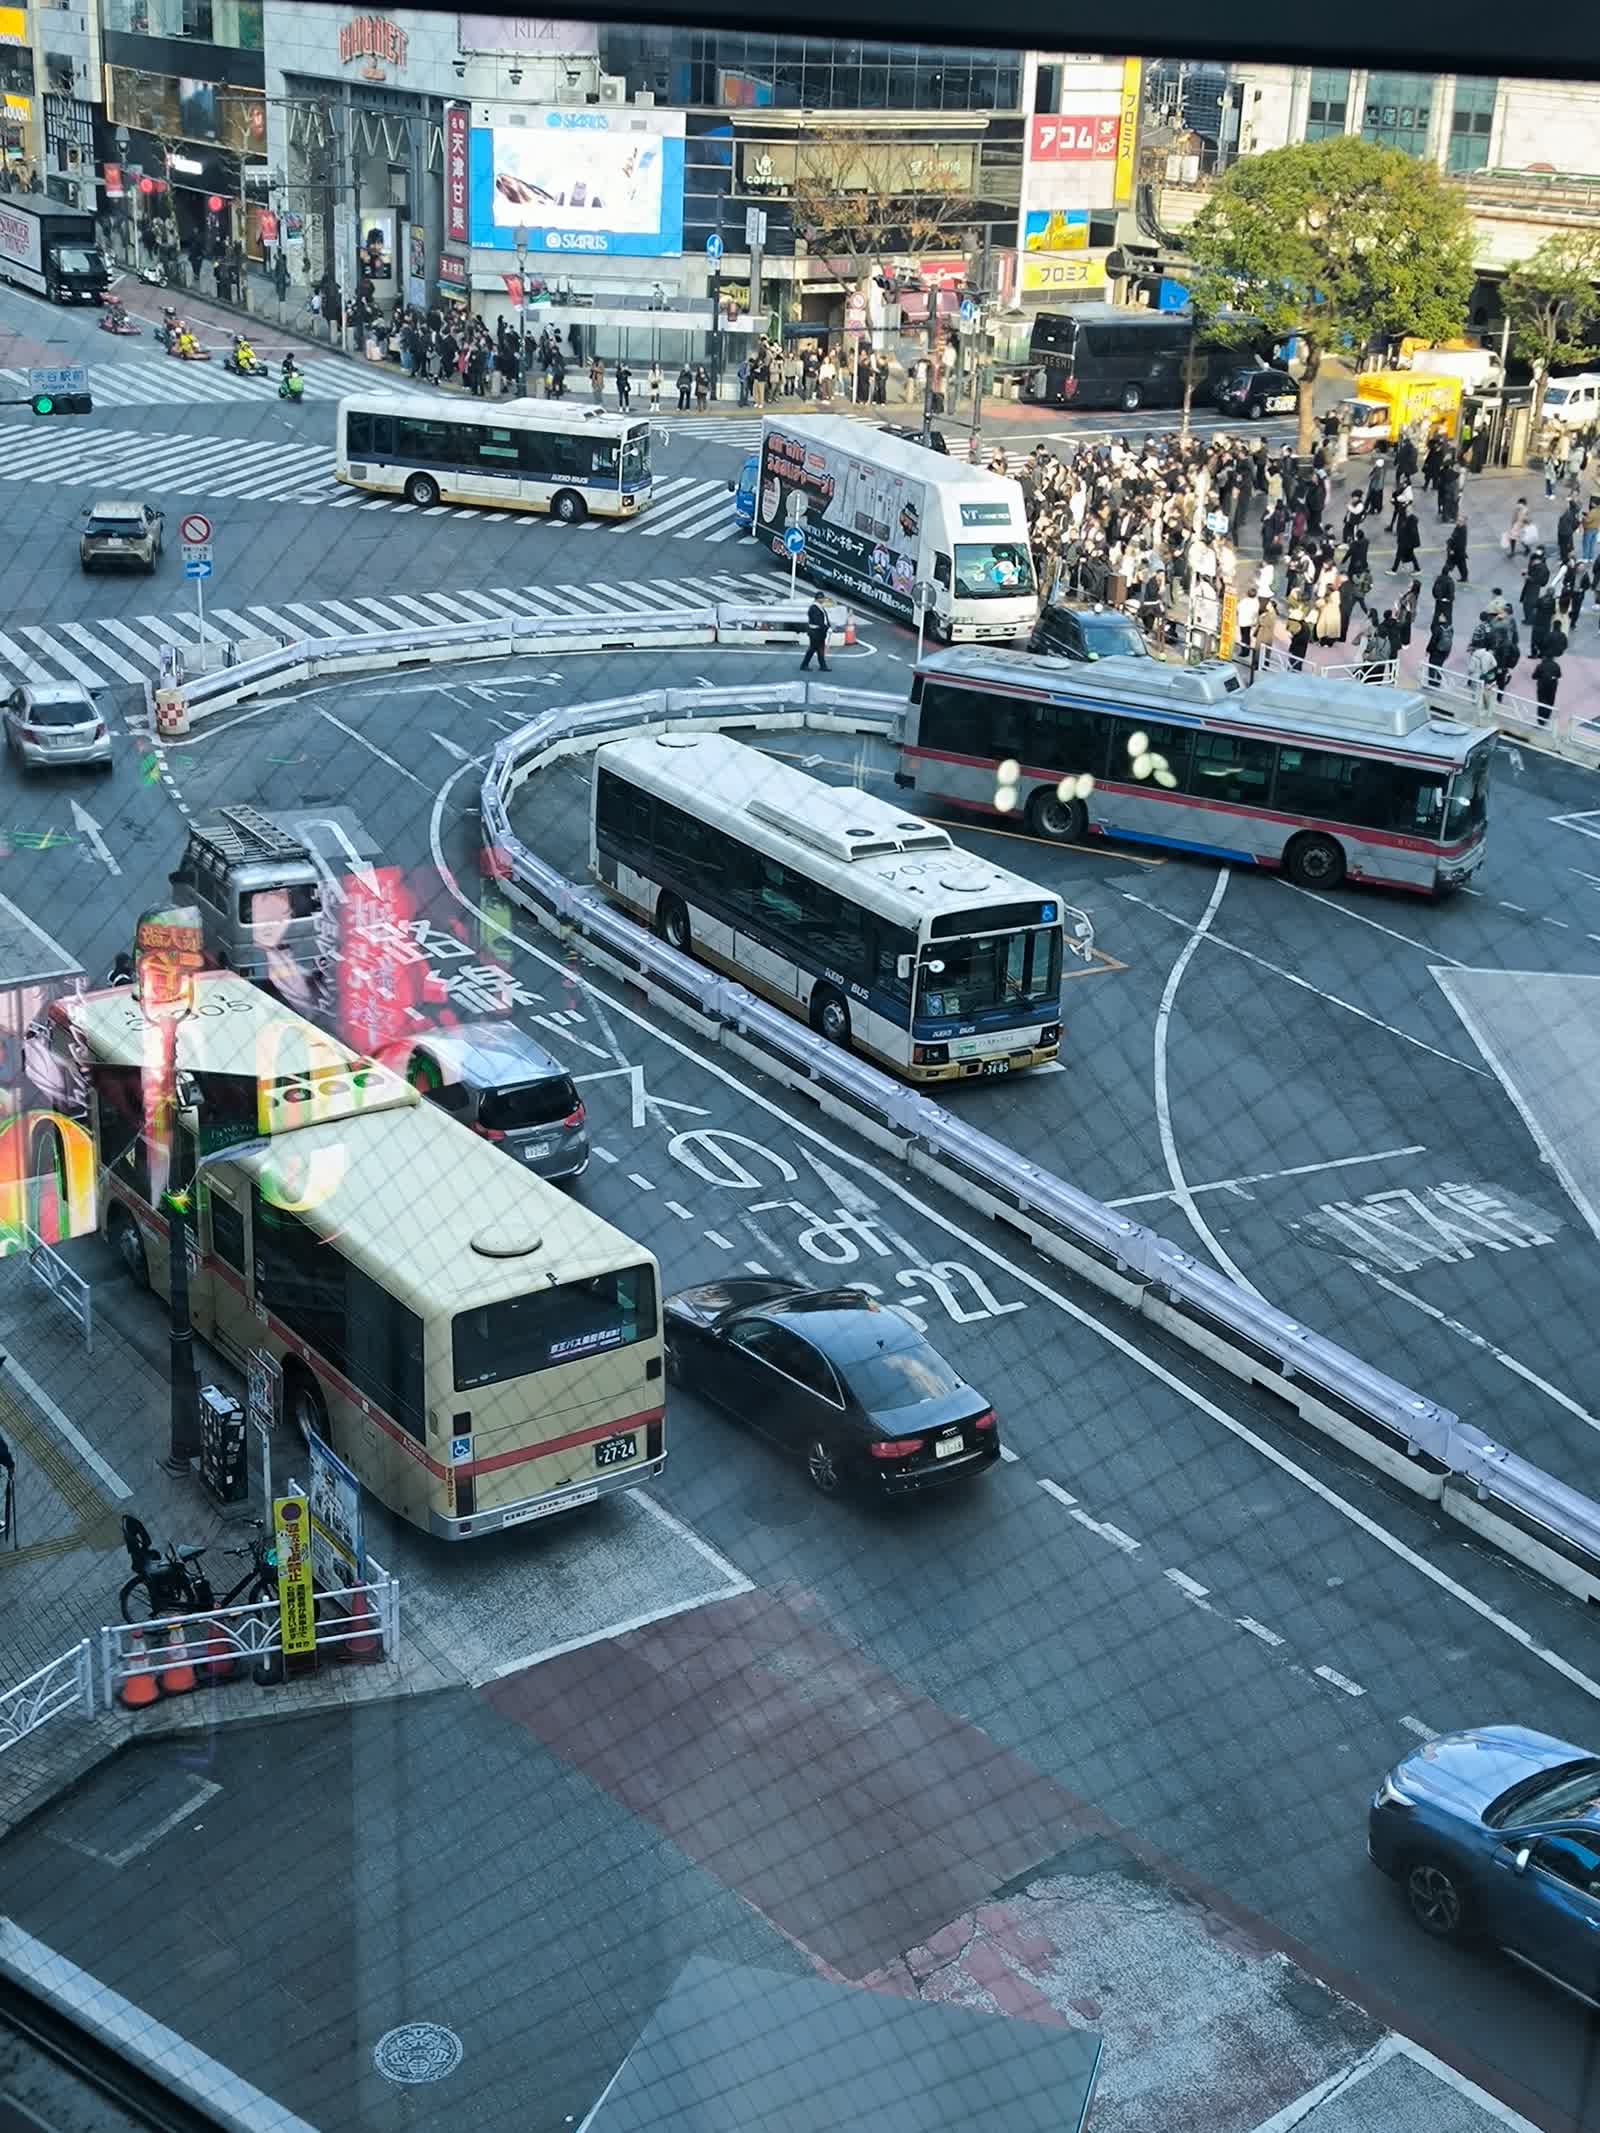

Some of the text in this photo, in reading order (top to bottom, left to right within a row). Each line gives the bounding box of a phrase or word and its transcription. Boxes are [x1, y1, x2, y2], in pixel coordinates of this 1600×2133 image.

[1121, 94, 1136, 160] プロミス
[1039, 125, 1093, 150] アコム
[452, 132, 465, 229] 天津甘栗
[746, 175, 785, 185] COFFEE
[1040, 265, 1089, 282] プロミス
[33, 370, 84, 382] 渋谷駅前
[962, 509, 978, 520] VT
[850, 982, 871, 1001] BUS
[958, 1025, 977, 1035] BUS
